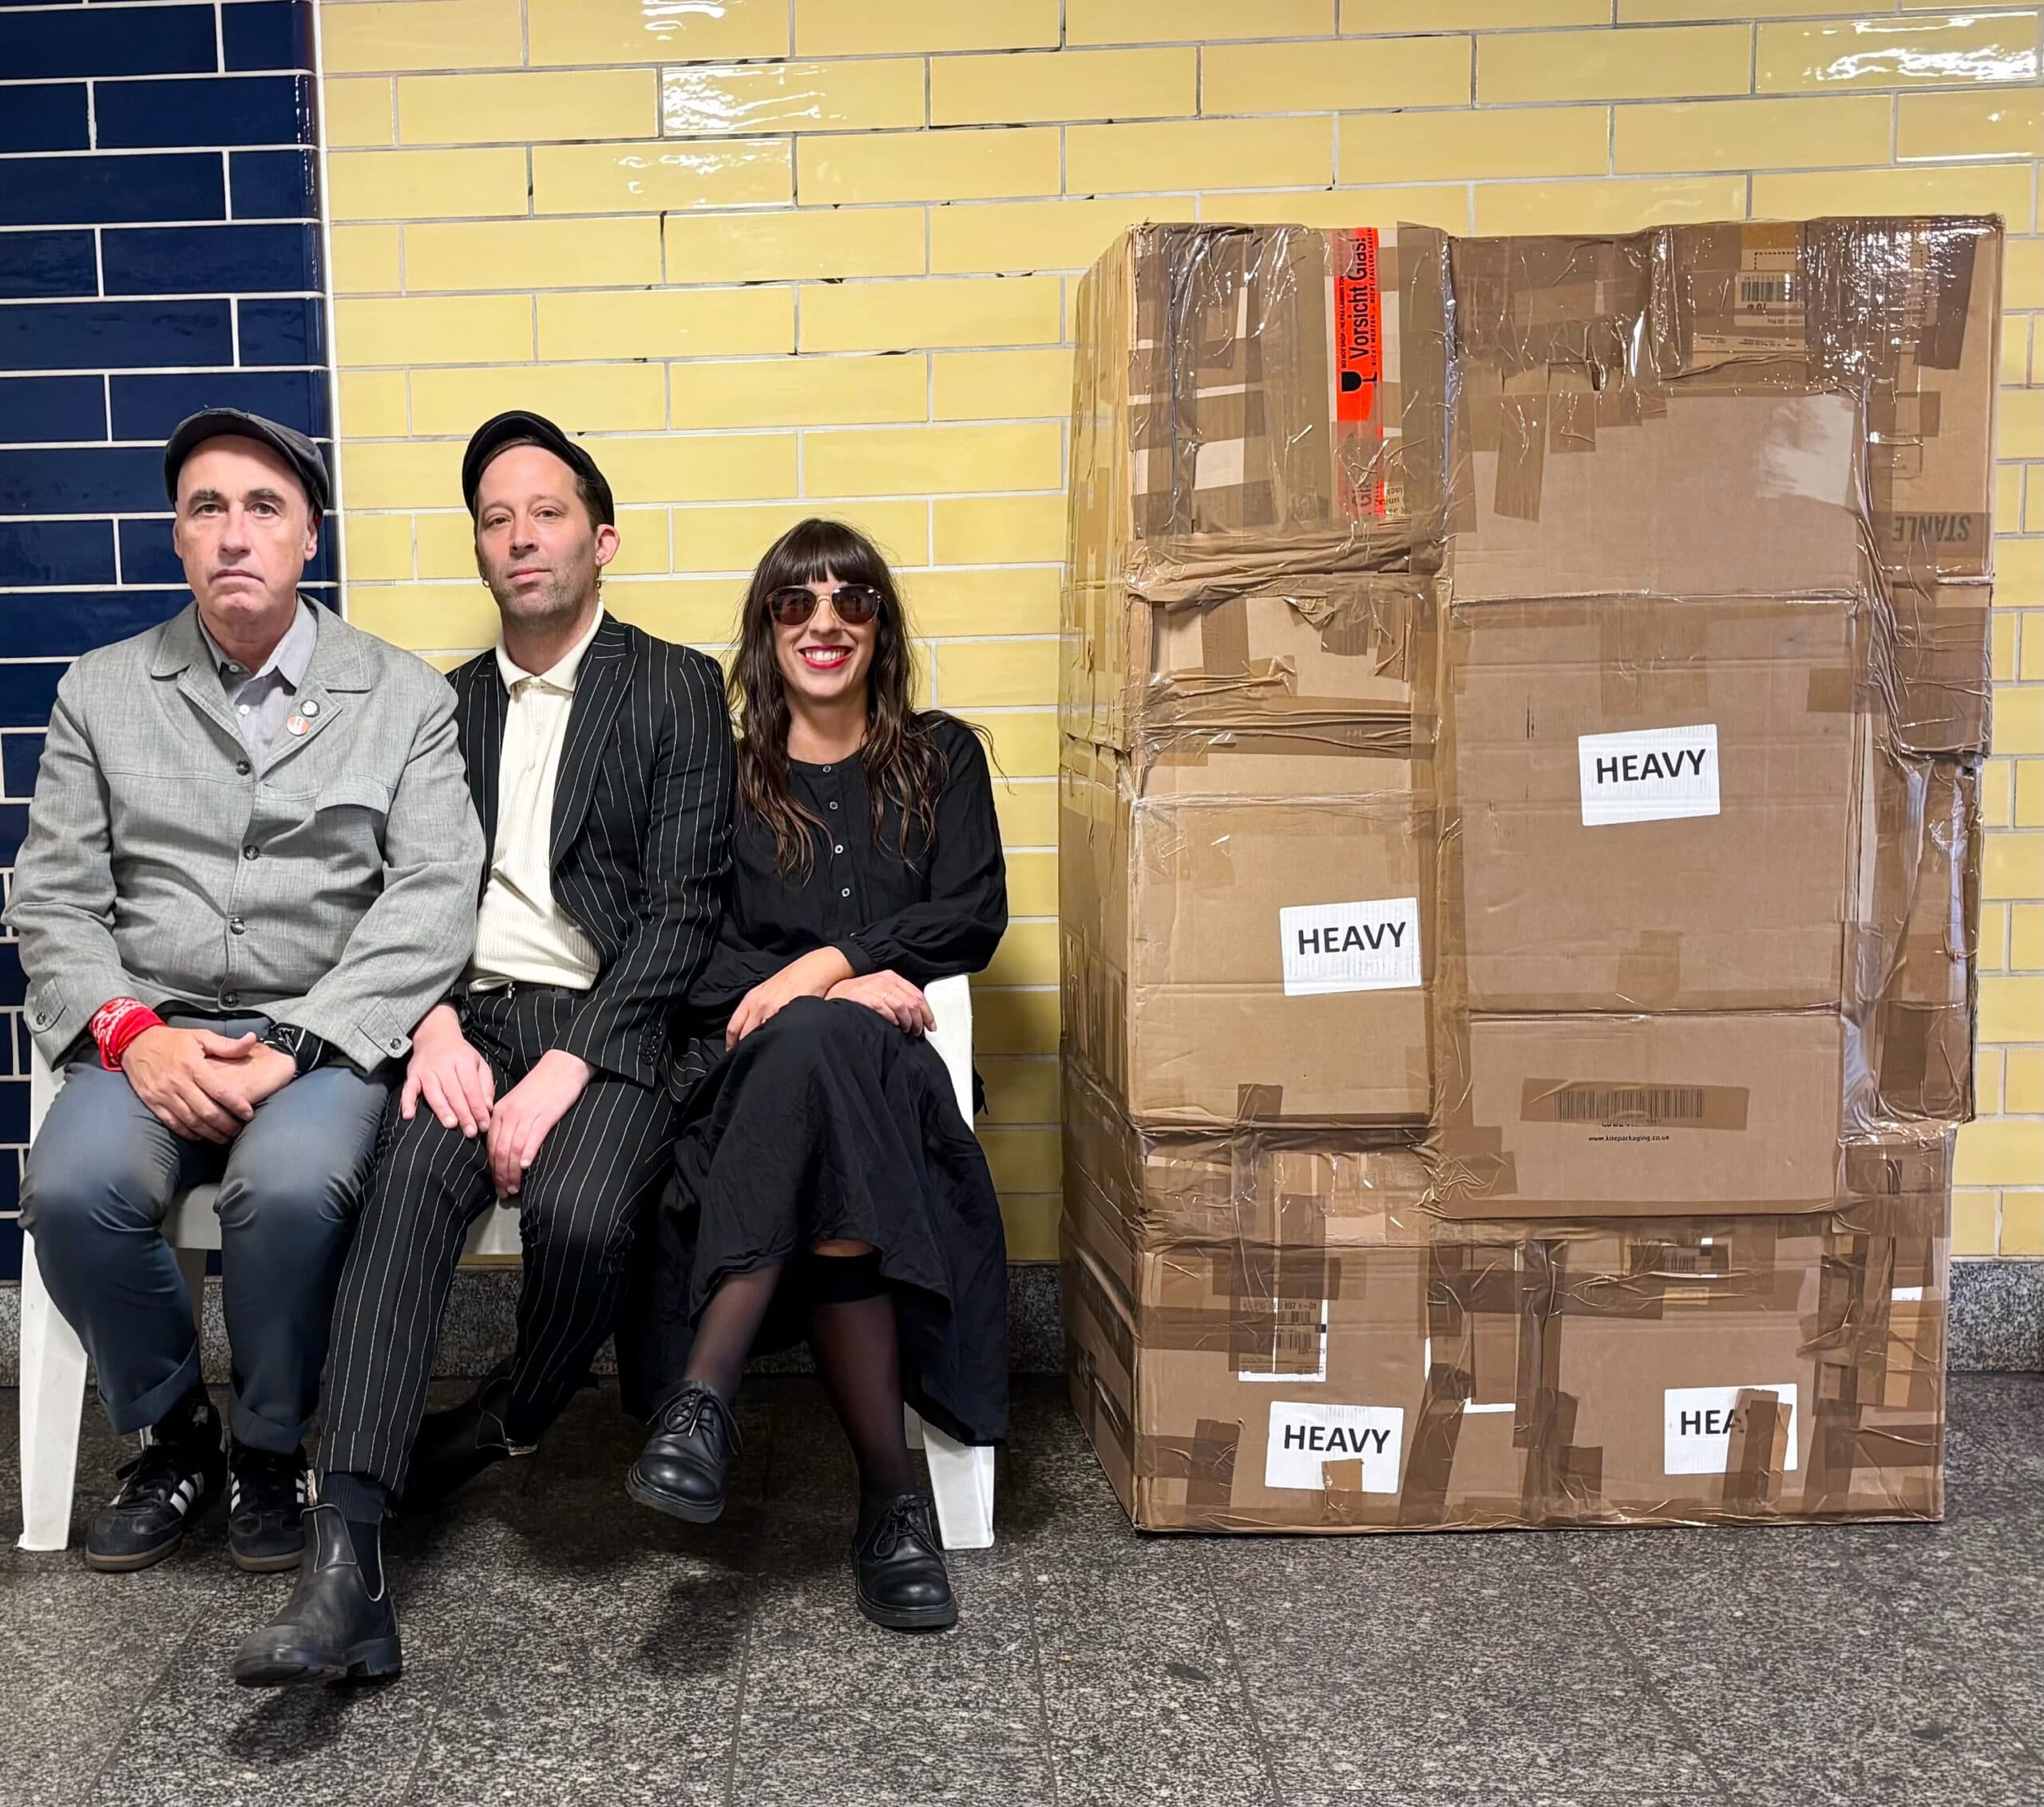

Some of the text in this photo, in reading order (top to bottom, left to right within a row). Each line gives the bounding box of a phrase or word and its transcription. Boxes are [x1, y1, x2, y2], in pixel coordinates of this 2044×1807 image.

[1348, 285, 1369, 360] Vorsicht
[1597, 748, 1706, 784] HEAVY
[1298, 921, 1406, 955] HEAVY
[1284, 1425, 1391, 1454] HEAVY
[1681, 1409, 1749, 1436] HEA
